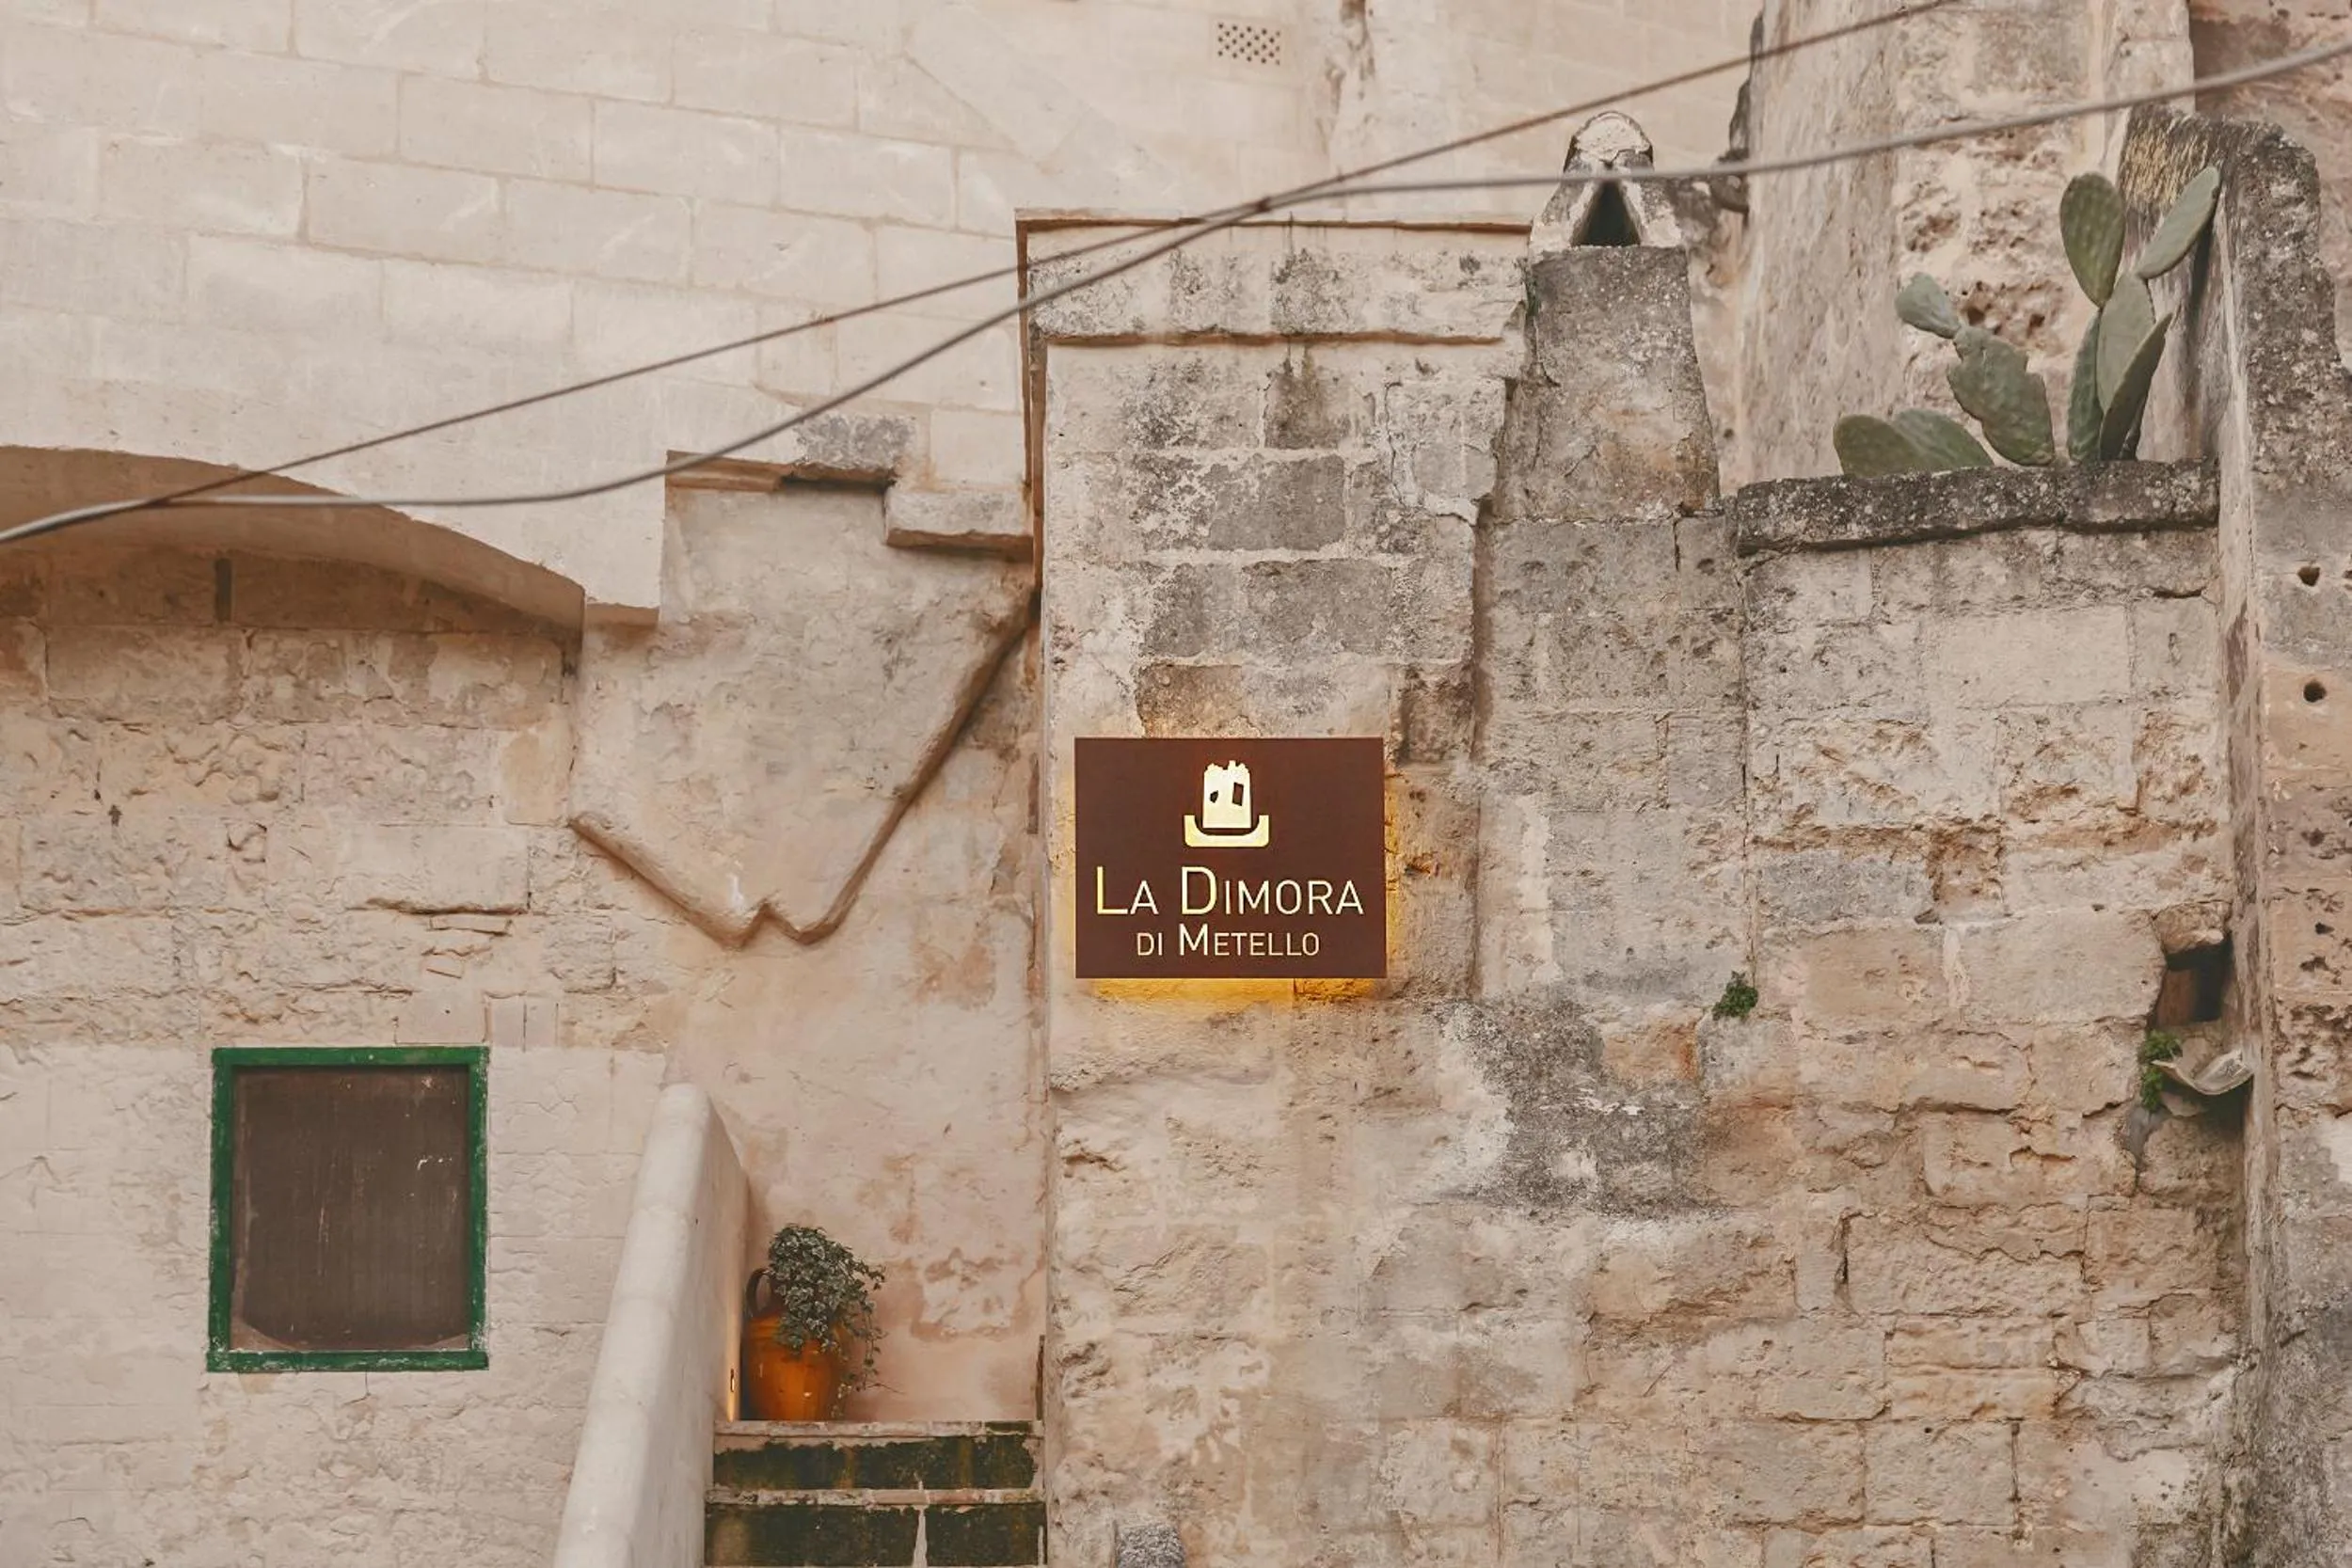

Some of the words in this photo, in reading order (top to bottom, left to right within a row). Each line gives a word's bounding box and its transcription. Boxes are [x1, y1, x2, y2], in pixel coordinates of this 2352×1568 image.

[1096, 865, 1159, 915] LA
[1181, 865, 1364, 915] DIMORA
[1136, 932, 1163, 957] DI
[1179, 923, 1320, 957] METELLO
